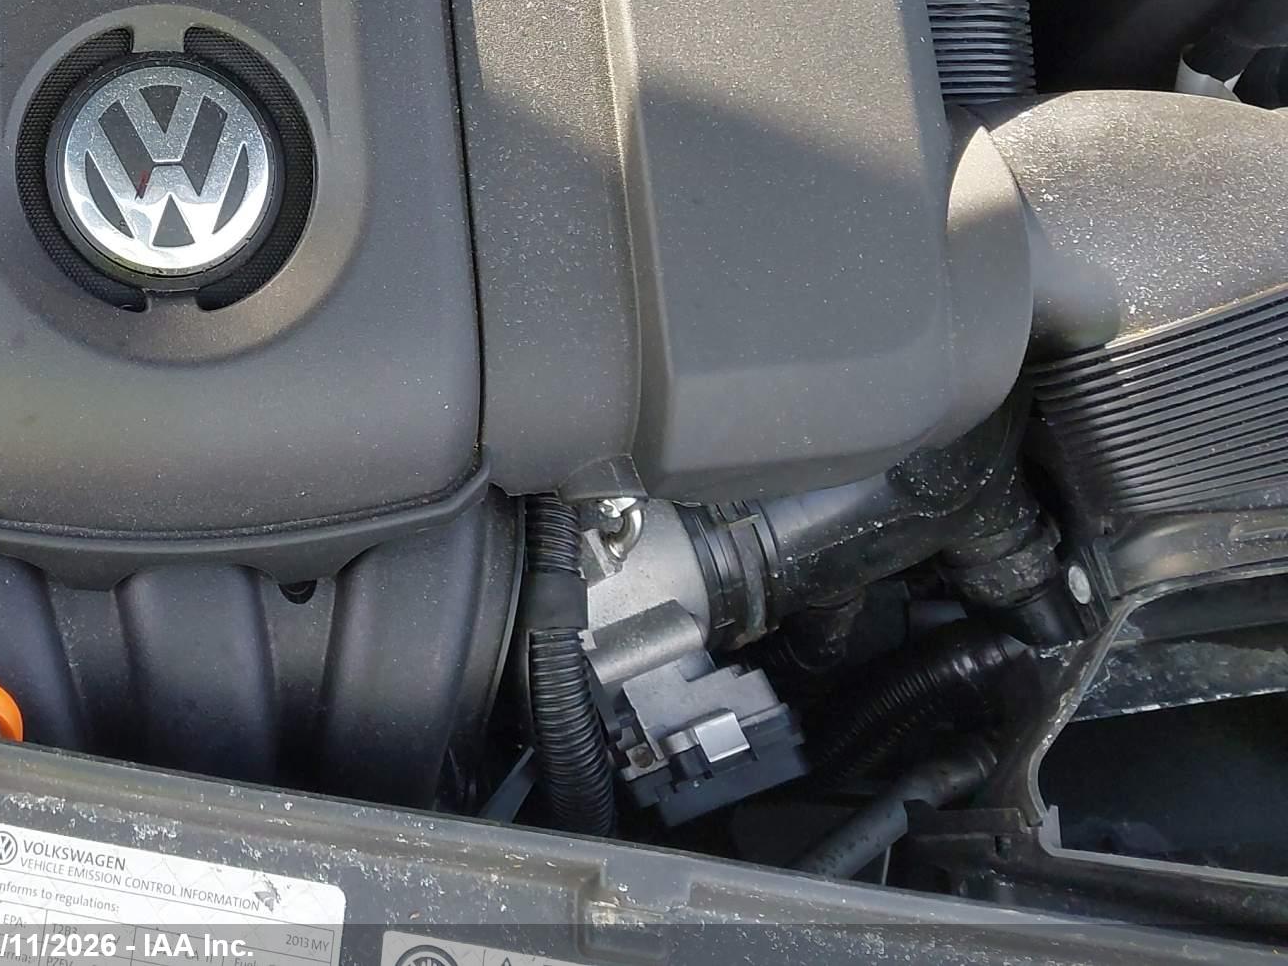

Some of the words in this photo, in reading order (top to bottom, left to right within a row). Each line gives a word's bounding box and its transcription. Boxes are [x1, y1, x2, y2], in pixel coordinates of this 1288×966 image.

[23, 839, 126, 871] VOLKSWAGEN
[20, 856, 65, 875] VEHICLE
[67, 864, 122, 886] EMISSION
[124, 876, 177, 897] CONTROL
[180, 886, 260, 912] INFORMATION
[41, 887, 53, 900] to
[54, 893, 120, 913] regulations:
[285, 933, 310, 949] 2013
[310, 938, 330, 952] MY
